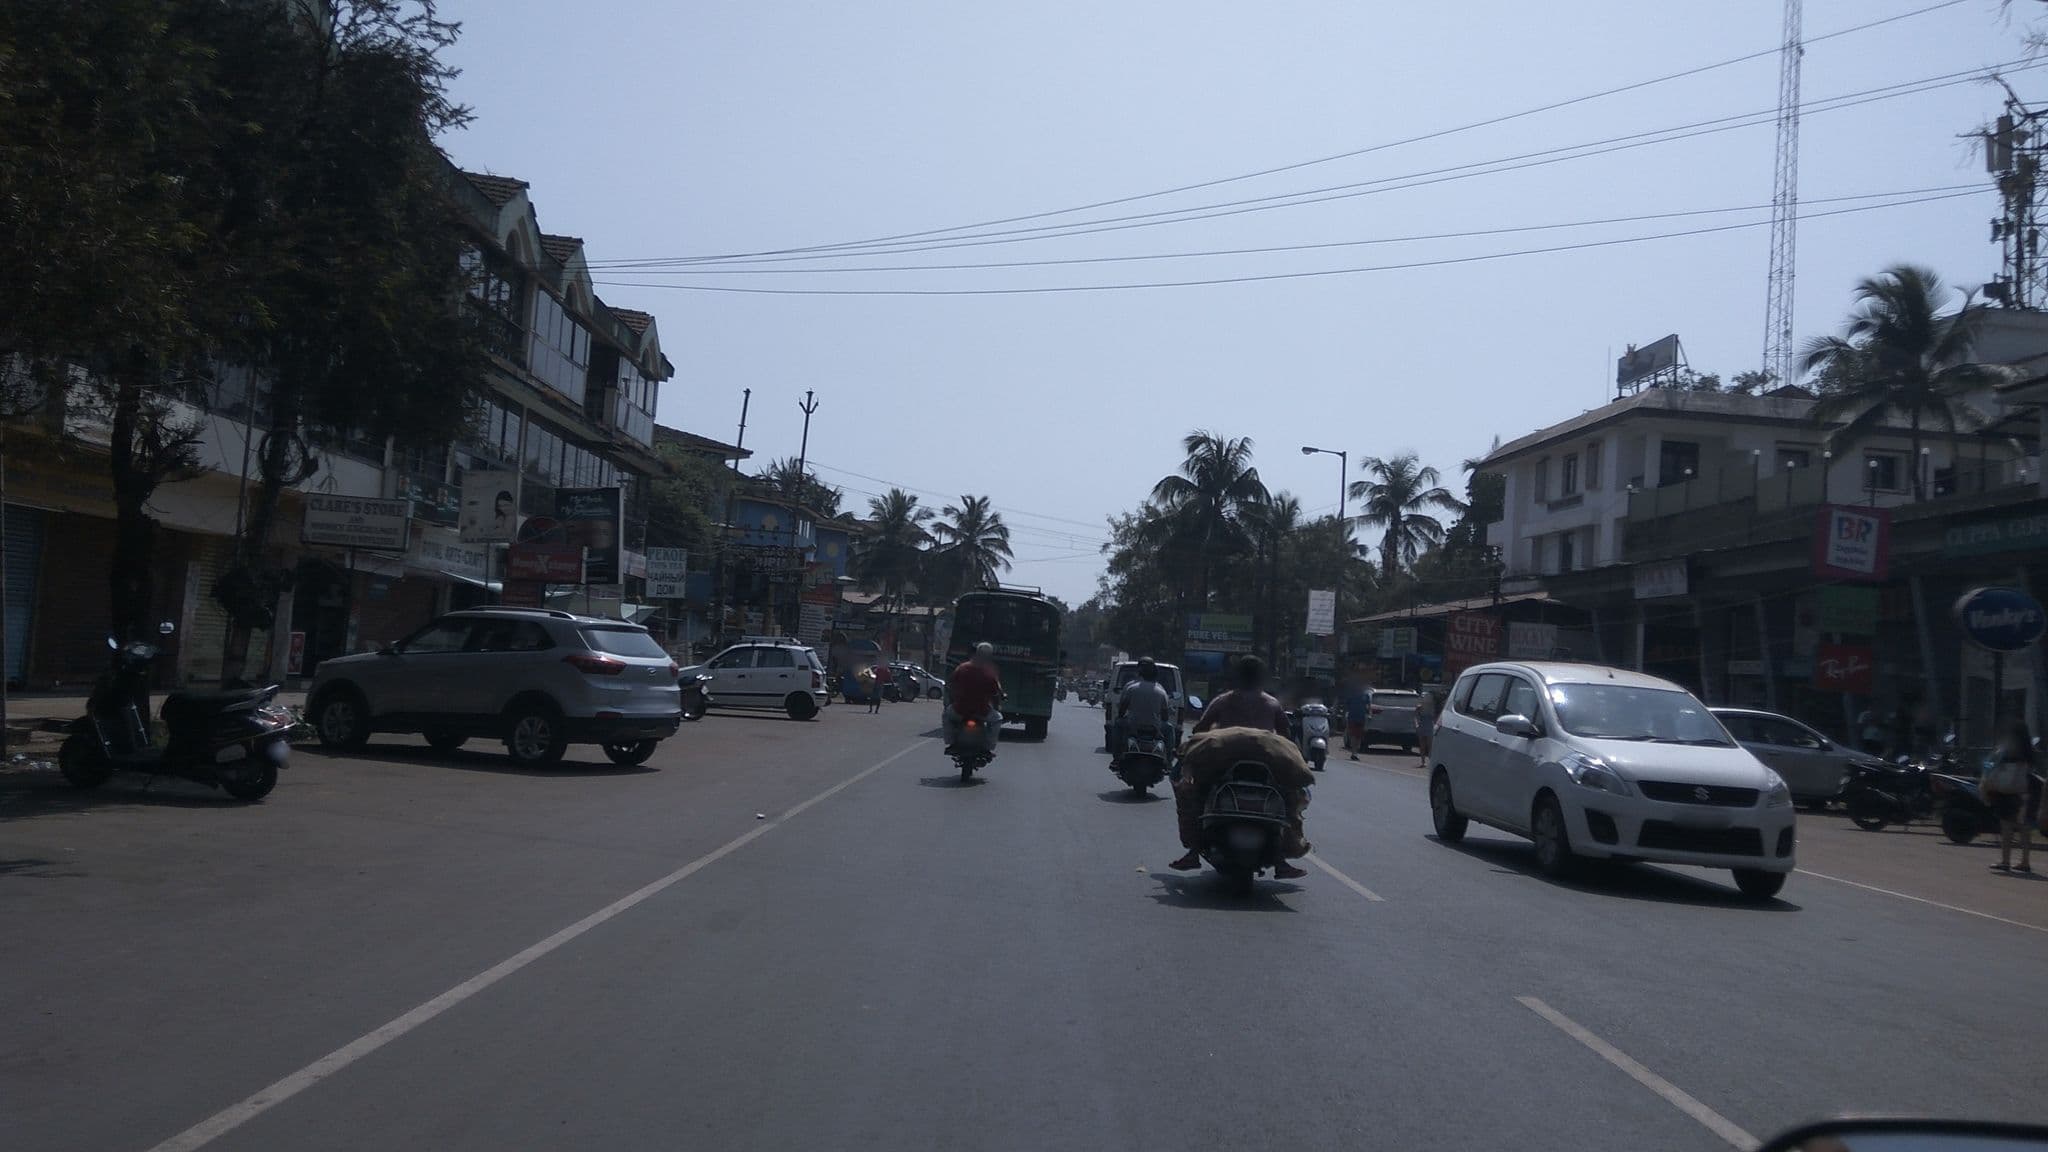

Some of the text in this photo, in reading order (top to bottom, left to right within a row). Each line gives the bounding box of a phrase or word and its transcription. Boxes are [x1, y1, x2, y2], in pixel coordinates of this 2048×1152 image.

[311, 499, 404, 516] CLARE'S STORE
[1838, 516, 1872, 544] BR
[656, 584, 675, 595] ДОМ
[1454, 615, 1498, 633] CITY
[1447, 633, 1498, 655] WINE
